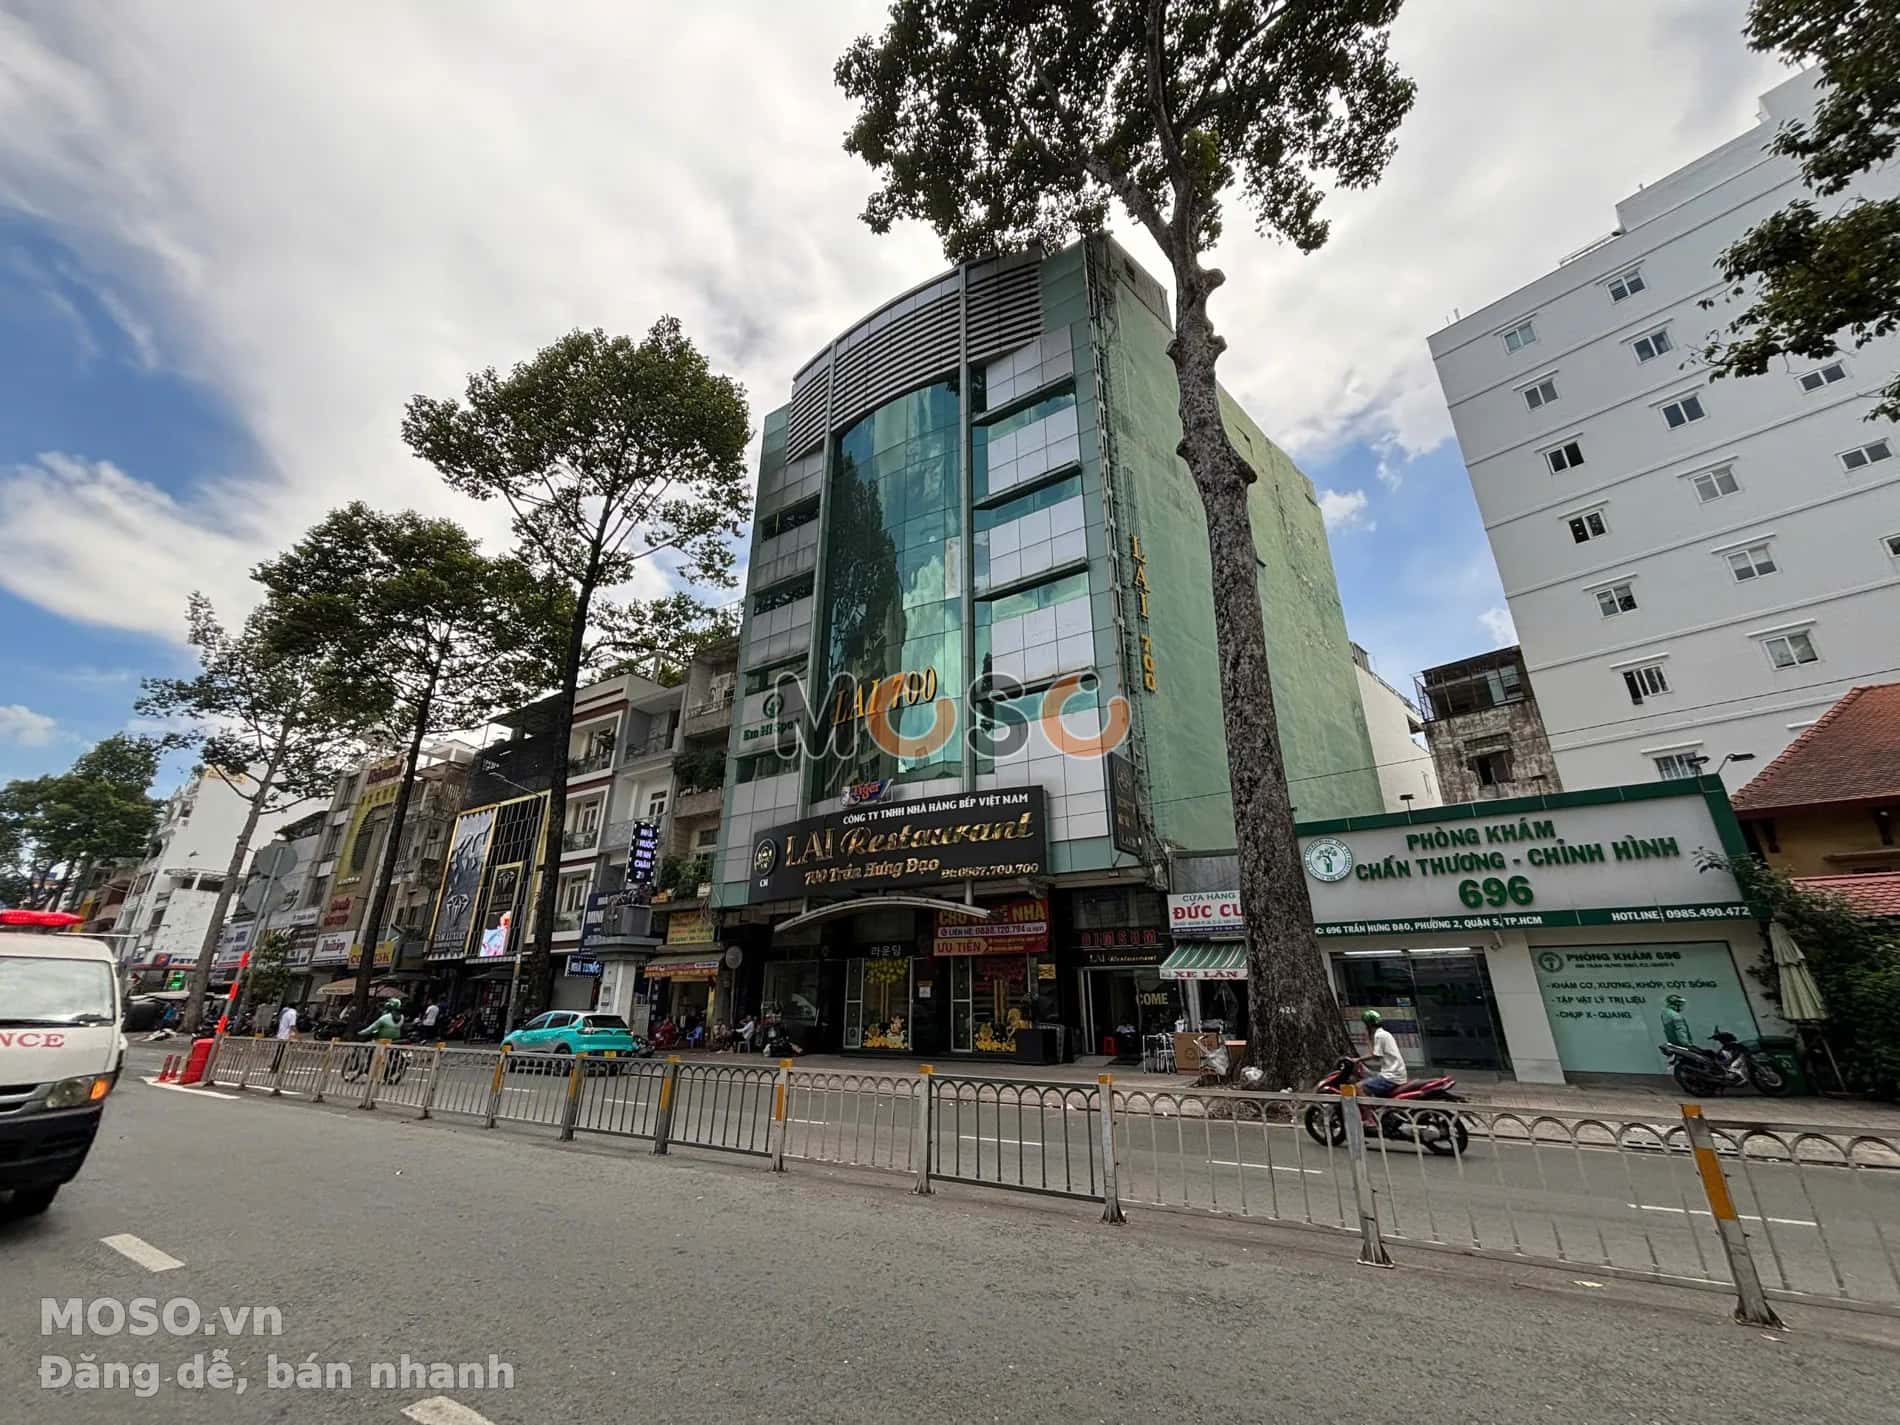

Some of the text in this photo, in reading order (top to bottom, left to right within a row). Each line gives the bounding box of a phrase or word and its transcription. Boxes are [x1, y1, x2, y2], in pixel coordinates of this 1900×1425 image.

[1131, 535, 1158, 693] LAI 700
[832, 665, 937, 726] LAI 700
[843, 794, 1029, 825] CÔNG TY TNHH NHÀ HÀNG BẾP VIỆT NAM
[785, 827, 836, 867] LAI
[840, 811, 1035, 857] Restaurant
[1406, 816, 1557, 851] PHÒNG KHÁM
[905, 857, 941, 876] Đạo
[1355, 854, 1412, 881] CHẤN
[1415, 851, 1506, 876] THƯƠNG
[1527, 838, 1605, 867] CHỈNH
[1611, 834, 1681, 861] HÌNH
[1458, 875, 1534, 909] 696
[1012, 900, 1046, 922] NHÀ
[1172, 902, 1212, 920] ĐỨC
[1611, 906, 1750, 922] HOTLINE: 0985.490.472
[1325, 926, 1342, 935] 696
[1342, 922, 1366, 934] TRẦN
[1367, 921, 1391, 934] HƯNG
[1414, 918, 1451, 931] PHƯỜNG
[1464, 916, 1491, 929] QUẬN
[1505, 915, 1543, 926] TP.HCM
[1566, 950, 1682, 963] PHÒNG KHÁM 696
[1175, 970, 1197, 979] XE
[1551, 980, 1578, 989] KHÁM
[1666, 979, 1686, 990] CỘT
[1689, 979, 1718, 988] SỐNG
[1598, 1011, 1633, 1019] QUANG
